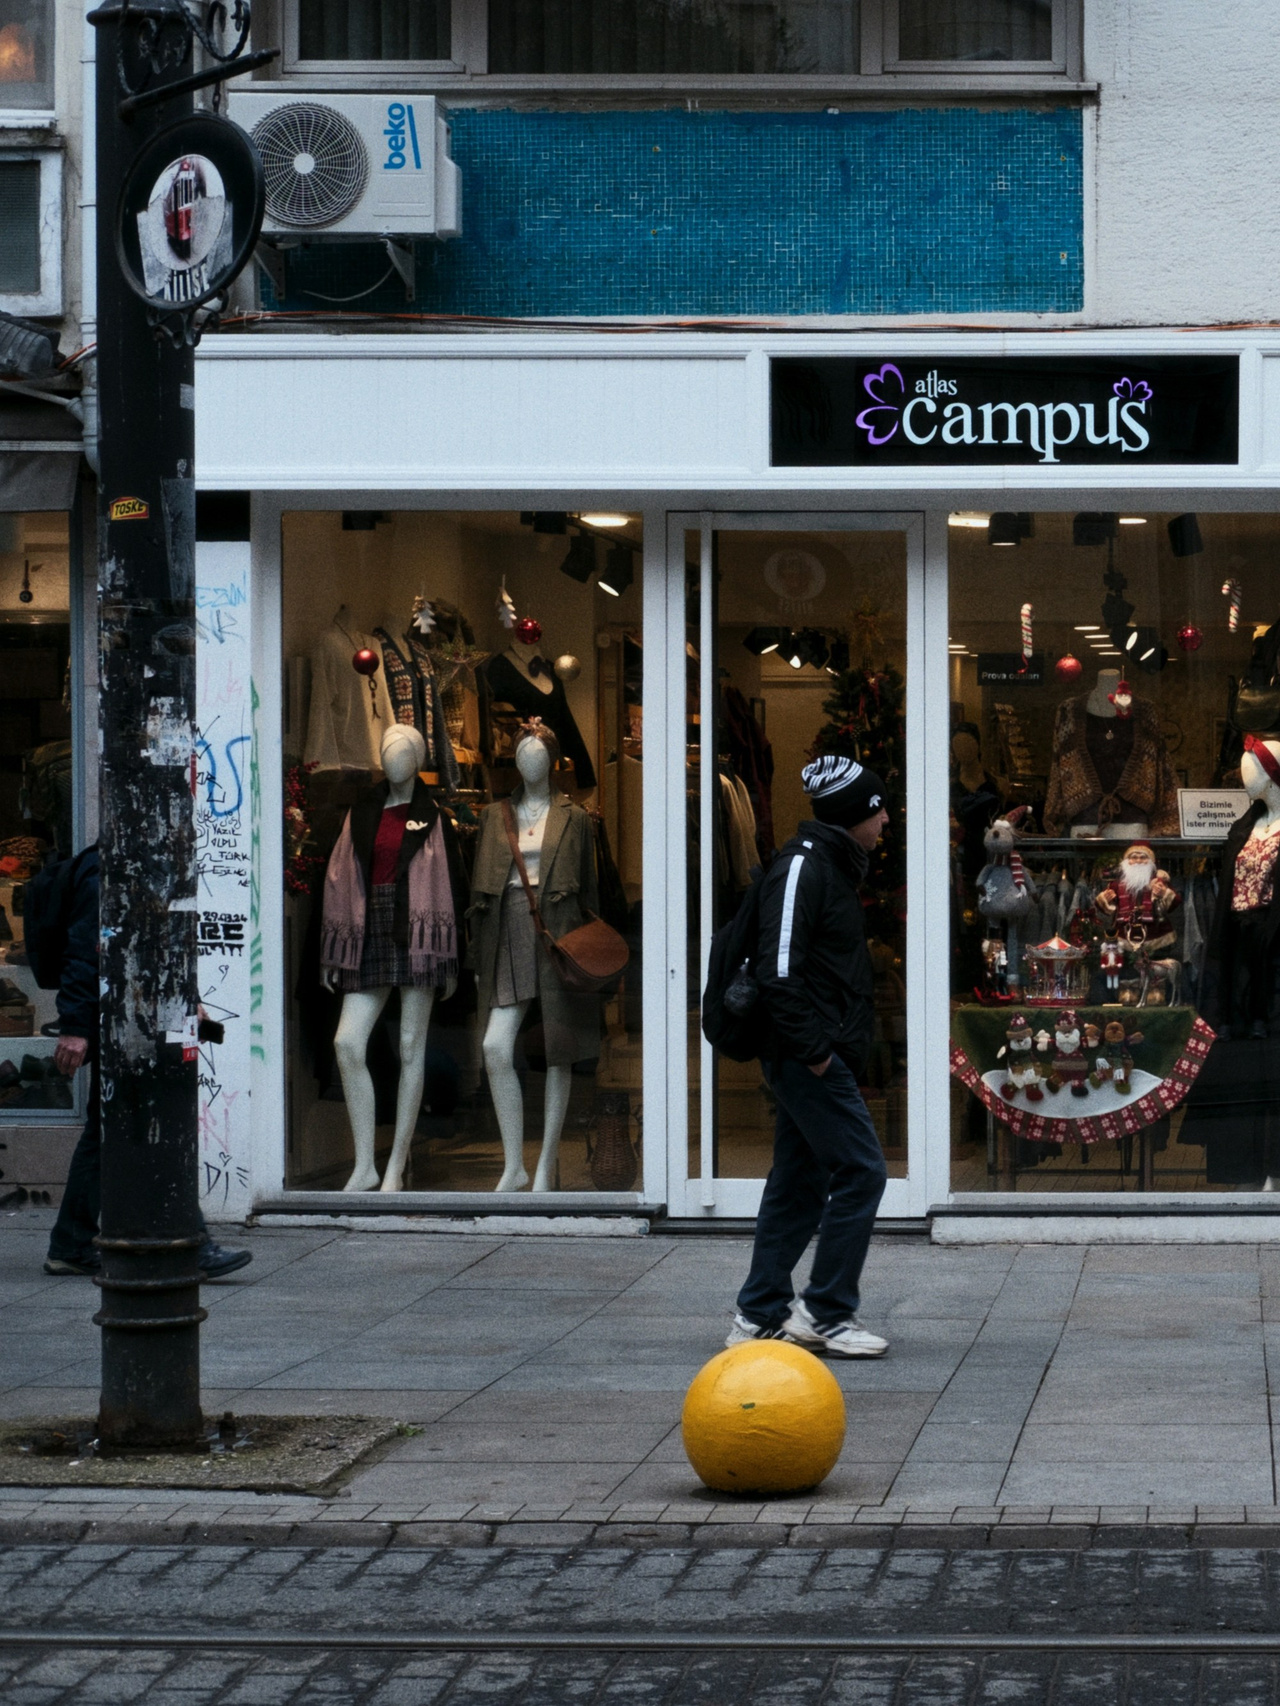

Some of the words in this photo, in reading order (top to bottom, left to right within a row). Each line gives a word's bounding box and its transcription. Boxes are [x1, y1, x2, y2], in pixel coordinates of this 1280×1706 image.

[383, 103, 406, 169] beko
[915, 369, 958, 398] atlas
[902, 396, 1151, 463] campus
[1196, 810, 1237, 819] çalışmak
[1200, 801, 1233, 809] Bizimle
[1186, 820, 1207, 828] ister
[1208, 820, 1234, 828] misin
